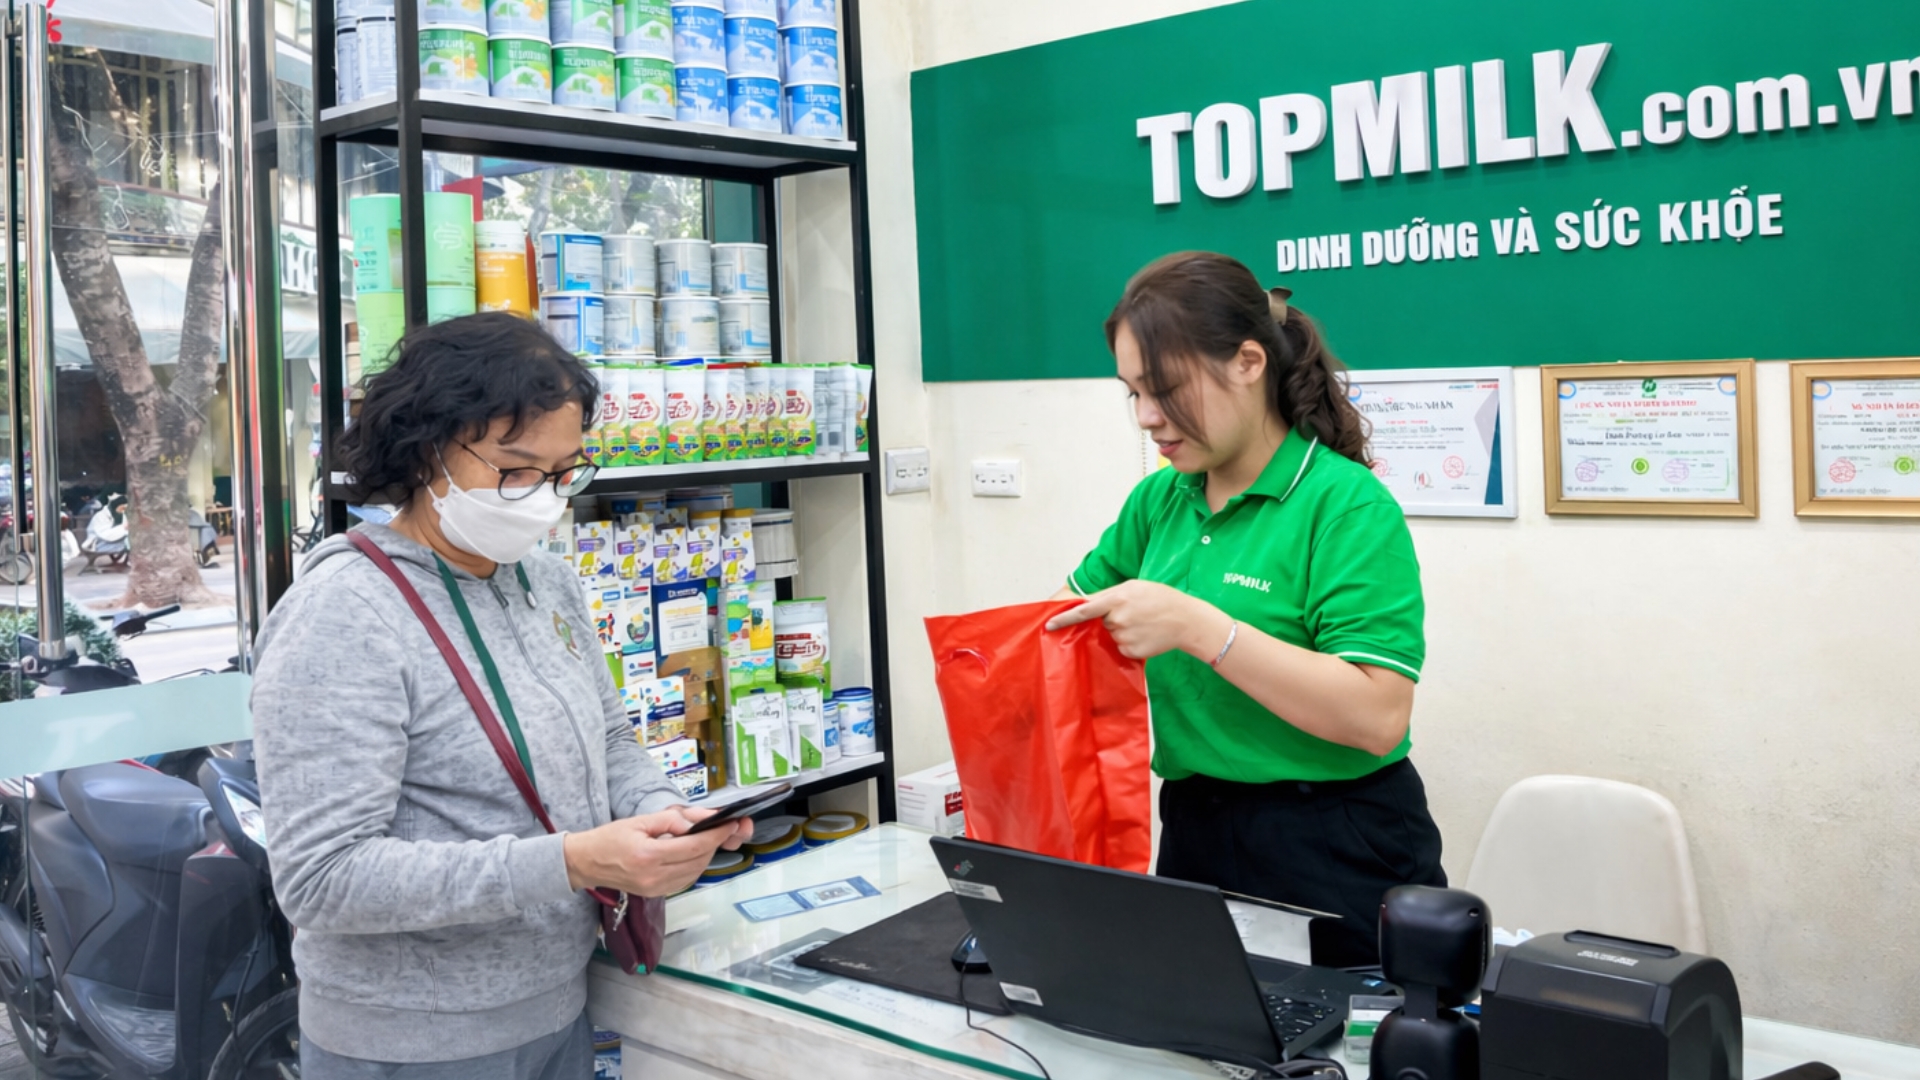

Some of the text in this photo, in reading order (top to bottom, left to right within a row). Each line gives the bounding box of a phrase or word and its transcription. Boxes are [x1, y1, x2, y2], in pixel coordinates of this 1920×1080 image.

[1276, 233, 1352, 273] DINH
[1361, 217, 1479, 266] DƯỠNG
[1490, 206, 1541, 255] VÀ
[1555, 198, 1640, 250] SỨC
